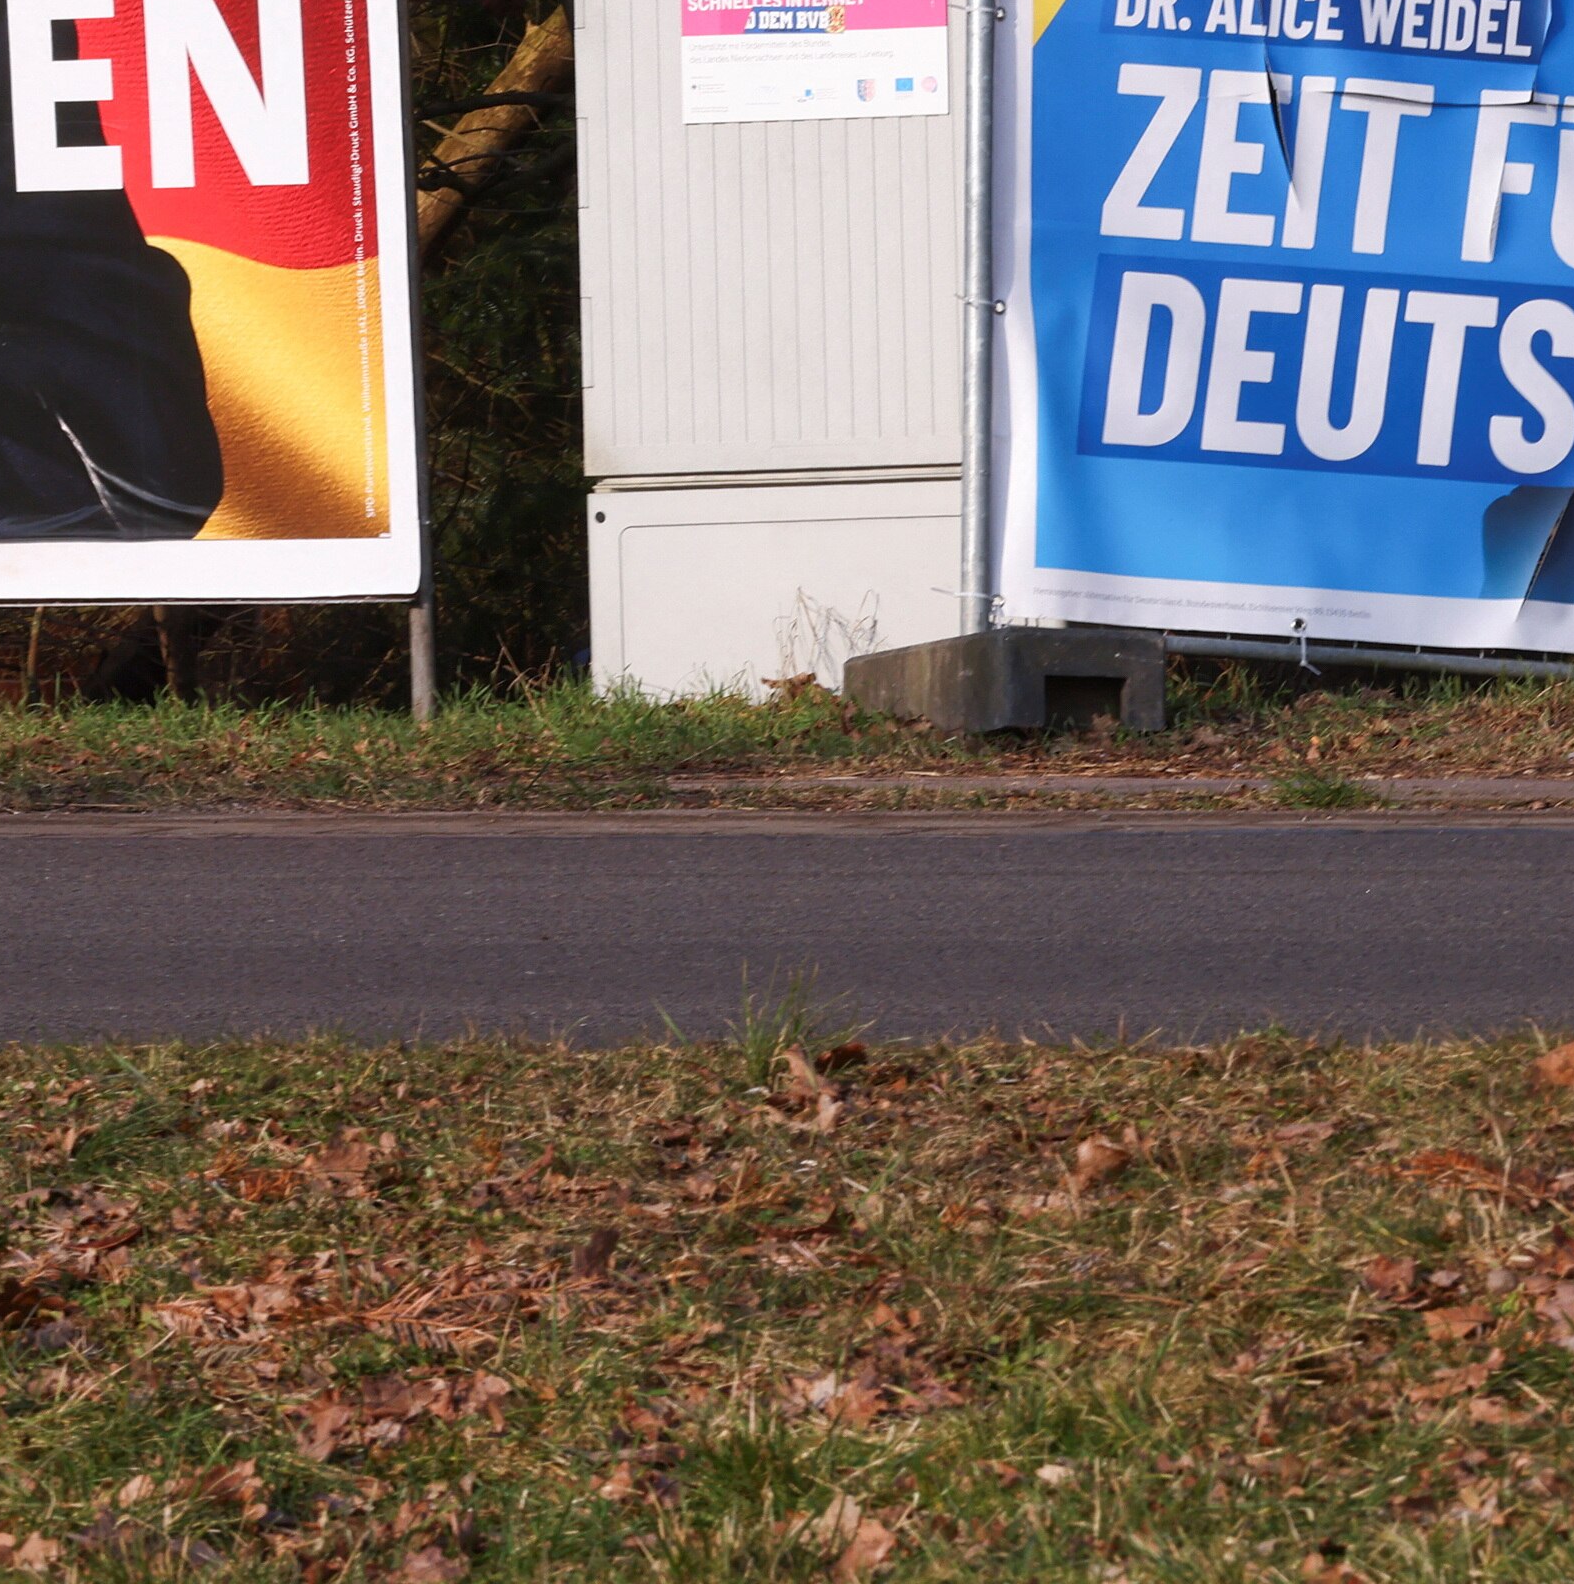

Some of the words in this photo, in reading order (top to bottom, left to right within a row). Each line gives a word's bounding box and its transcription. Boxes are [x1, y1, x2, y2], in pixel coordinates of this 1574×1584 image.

[758, 11, 793, 29] DEM
[345, 45, 357, 63] KG,
[346, 65, 357, 83] Co.
[346, 84, 357, 94] &
[347, 95, 359, 129] GmbH
[349, 130, 363, 206] Staudigl-Druck
[1100, 63, 1433, 256] ZEIT
[353, 208, 363, 241] Druck:
